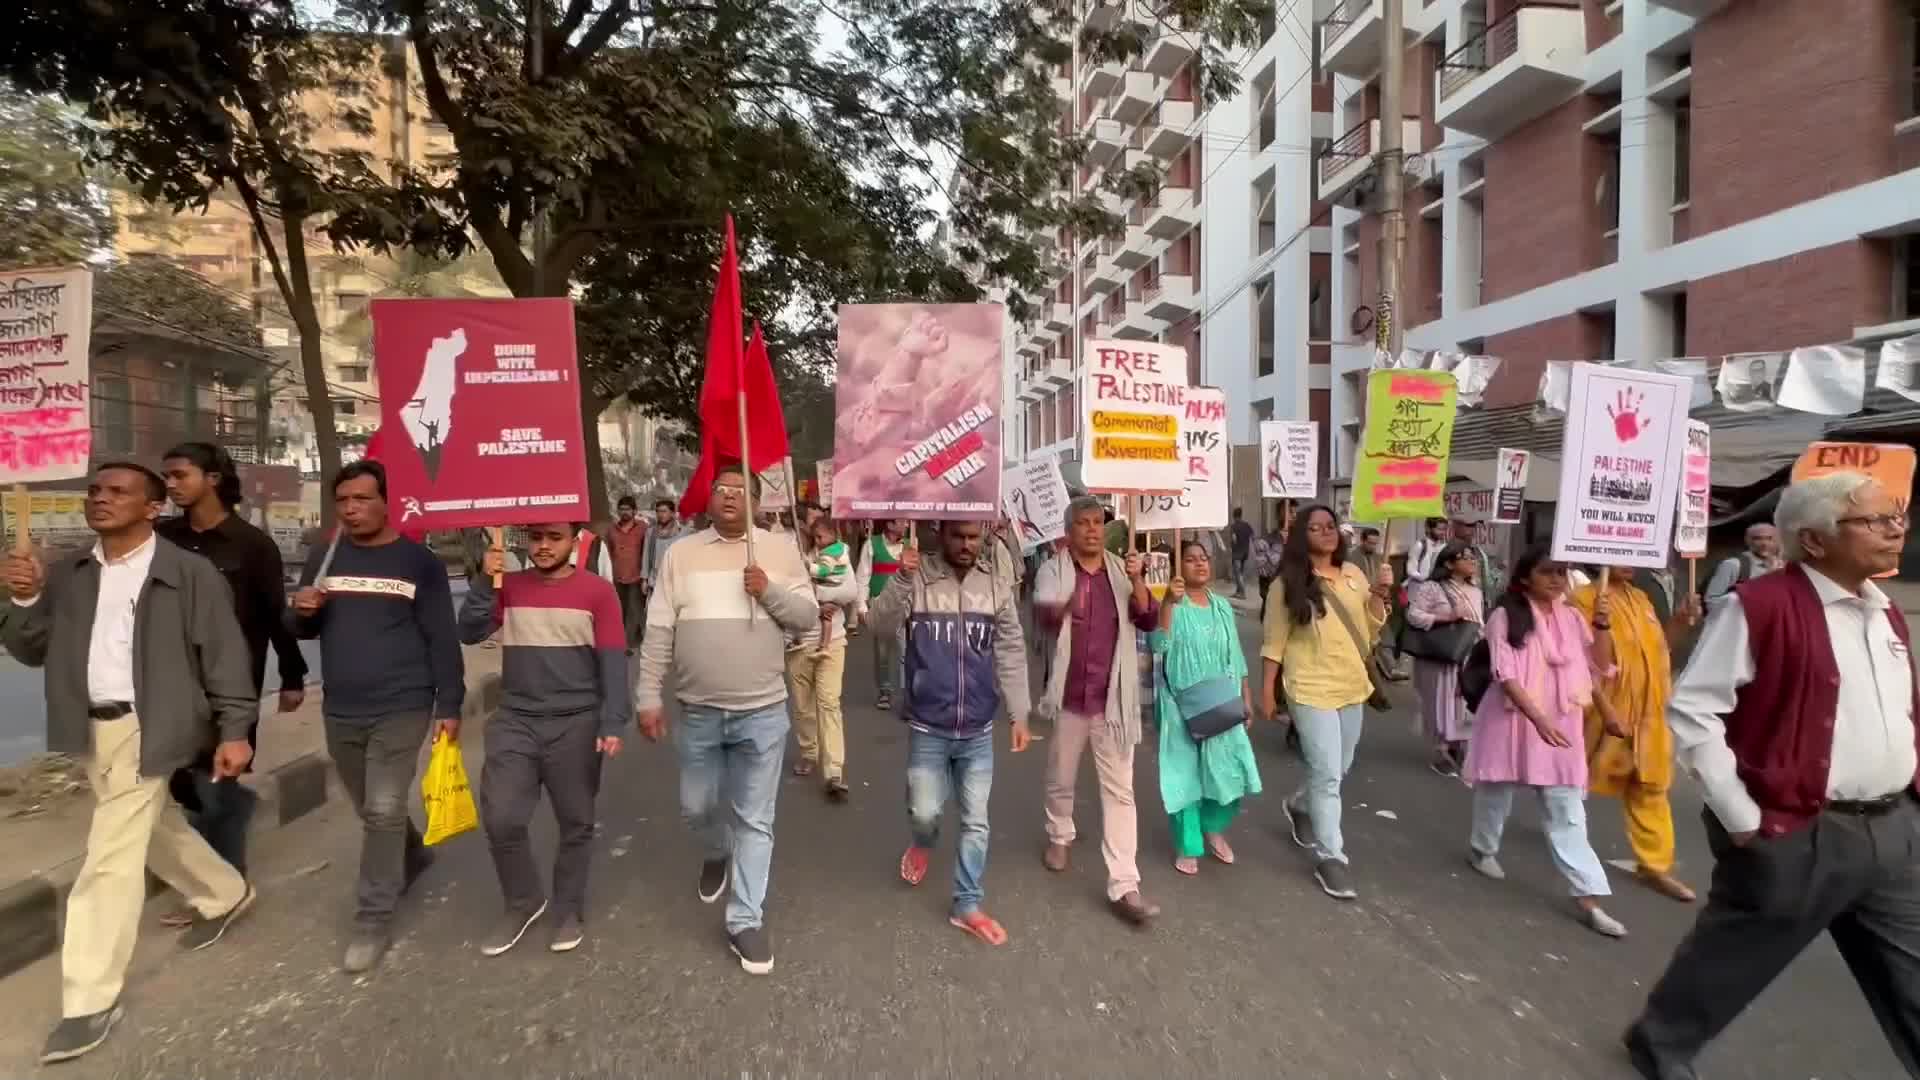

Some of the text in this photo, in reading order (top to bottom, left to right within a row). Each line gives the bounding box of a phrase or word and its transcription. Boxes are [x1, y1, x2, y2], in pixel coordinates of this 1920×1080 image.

[496, 358, 536, 369] WITH
[1095, 348, 1161, 377] FREE
[1093, 411, 1171, 432] Communist
[501, 428, 543, 441] SAVE
[895, 401, 994, 477] CAPITALISM
[477, 440, 567, 456] PALESTINE
[1096, 437, 1181, 460] Movement
[1816, 445, 1881, 468] END
[943, 453, 987, 488] WAR
[1593, 455, 1654, 475] PALESTINE
[1580, 508, 1656, 524] YOU WILL NEVER
[1587, 524, 1645, 538] WALK ALONE
